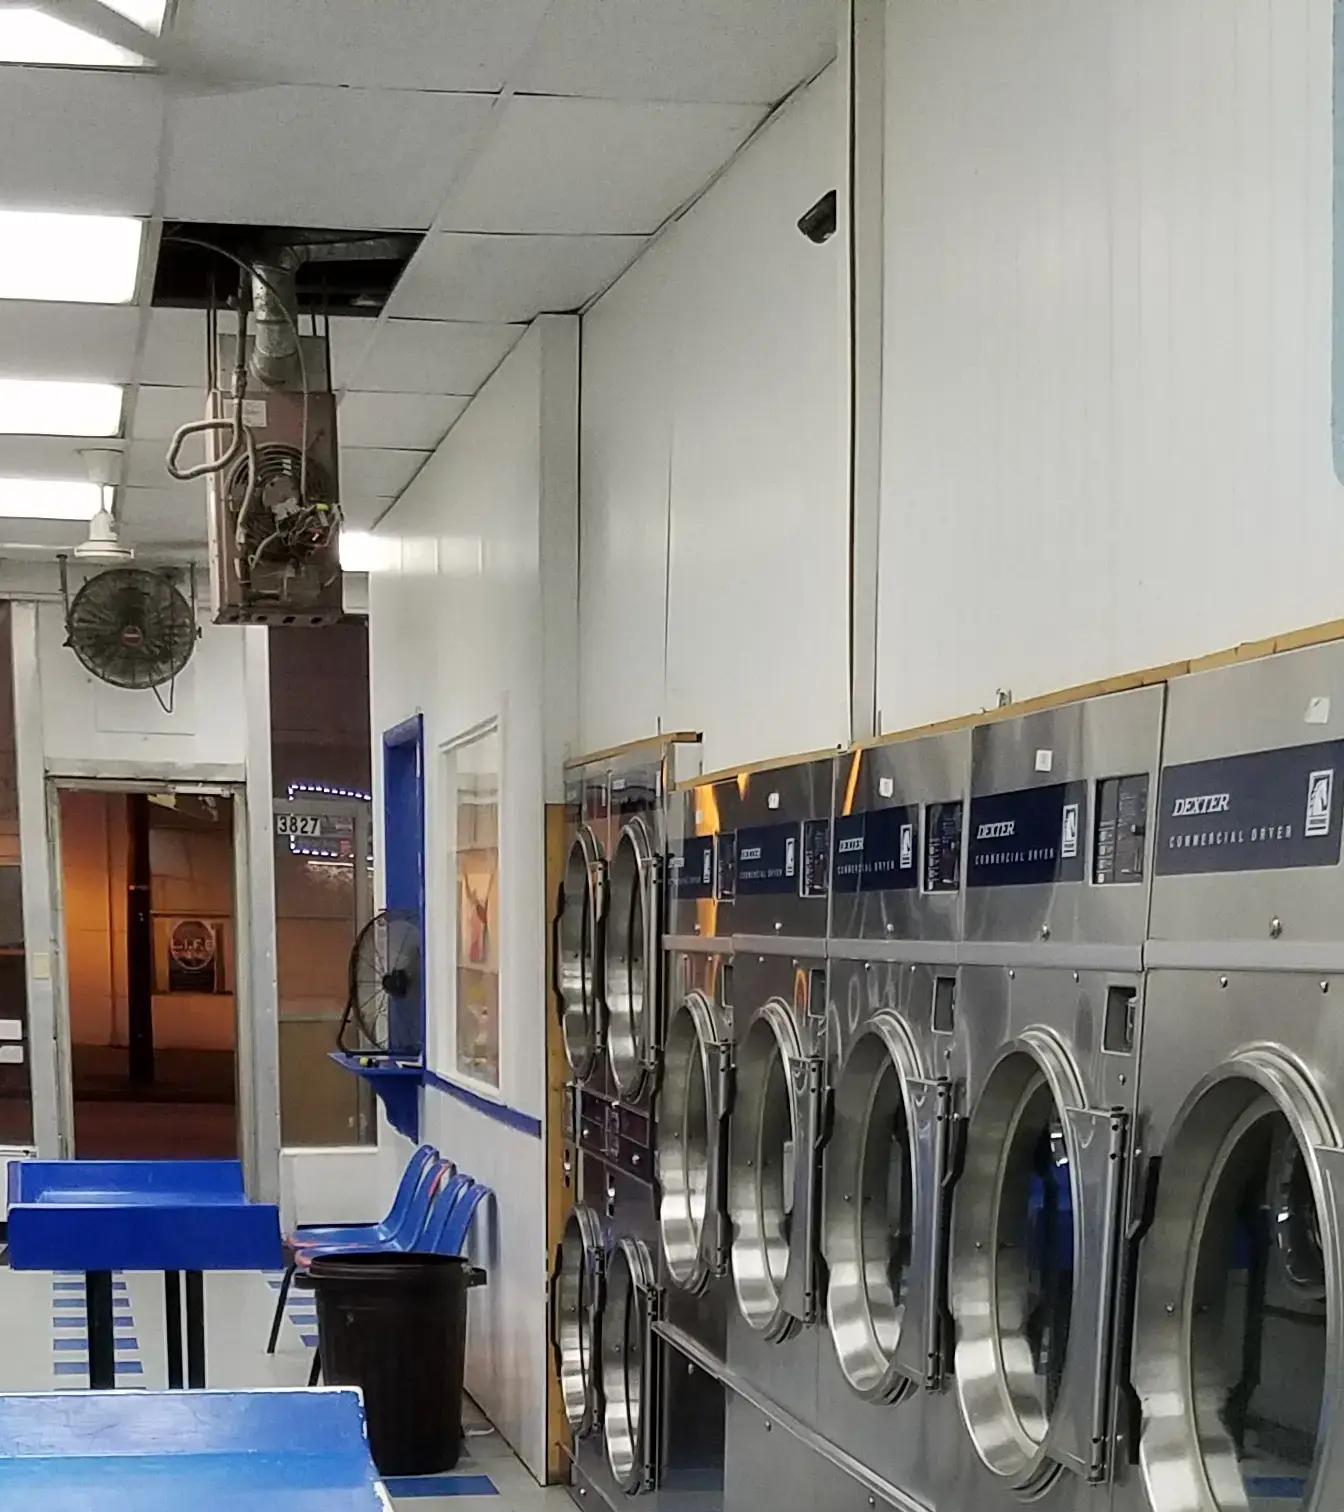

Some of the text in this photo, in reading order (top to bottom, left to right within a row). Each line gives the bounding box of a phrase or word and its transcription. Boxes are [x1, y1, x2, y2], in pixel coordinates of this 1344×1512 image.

[1171, 793, 1231, 817] DEXTER
[279, 815, 319, 835] 3827
[976, 820, 1015, 840] DEXTER
[1169, 824, 1293, 849] COMMERCIAL DRYER
